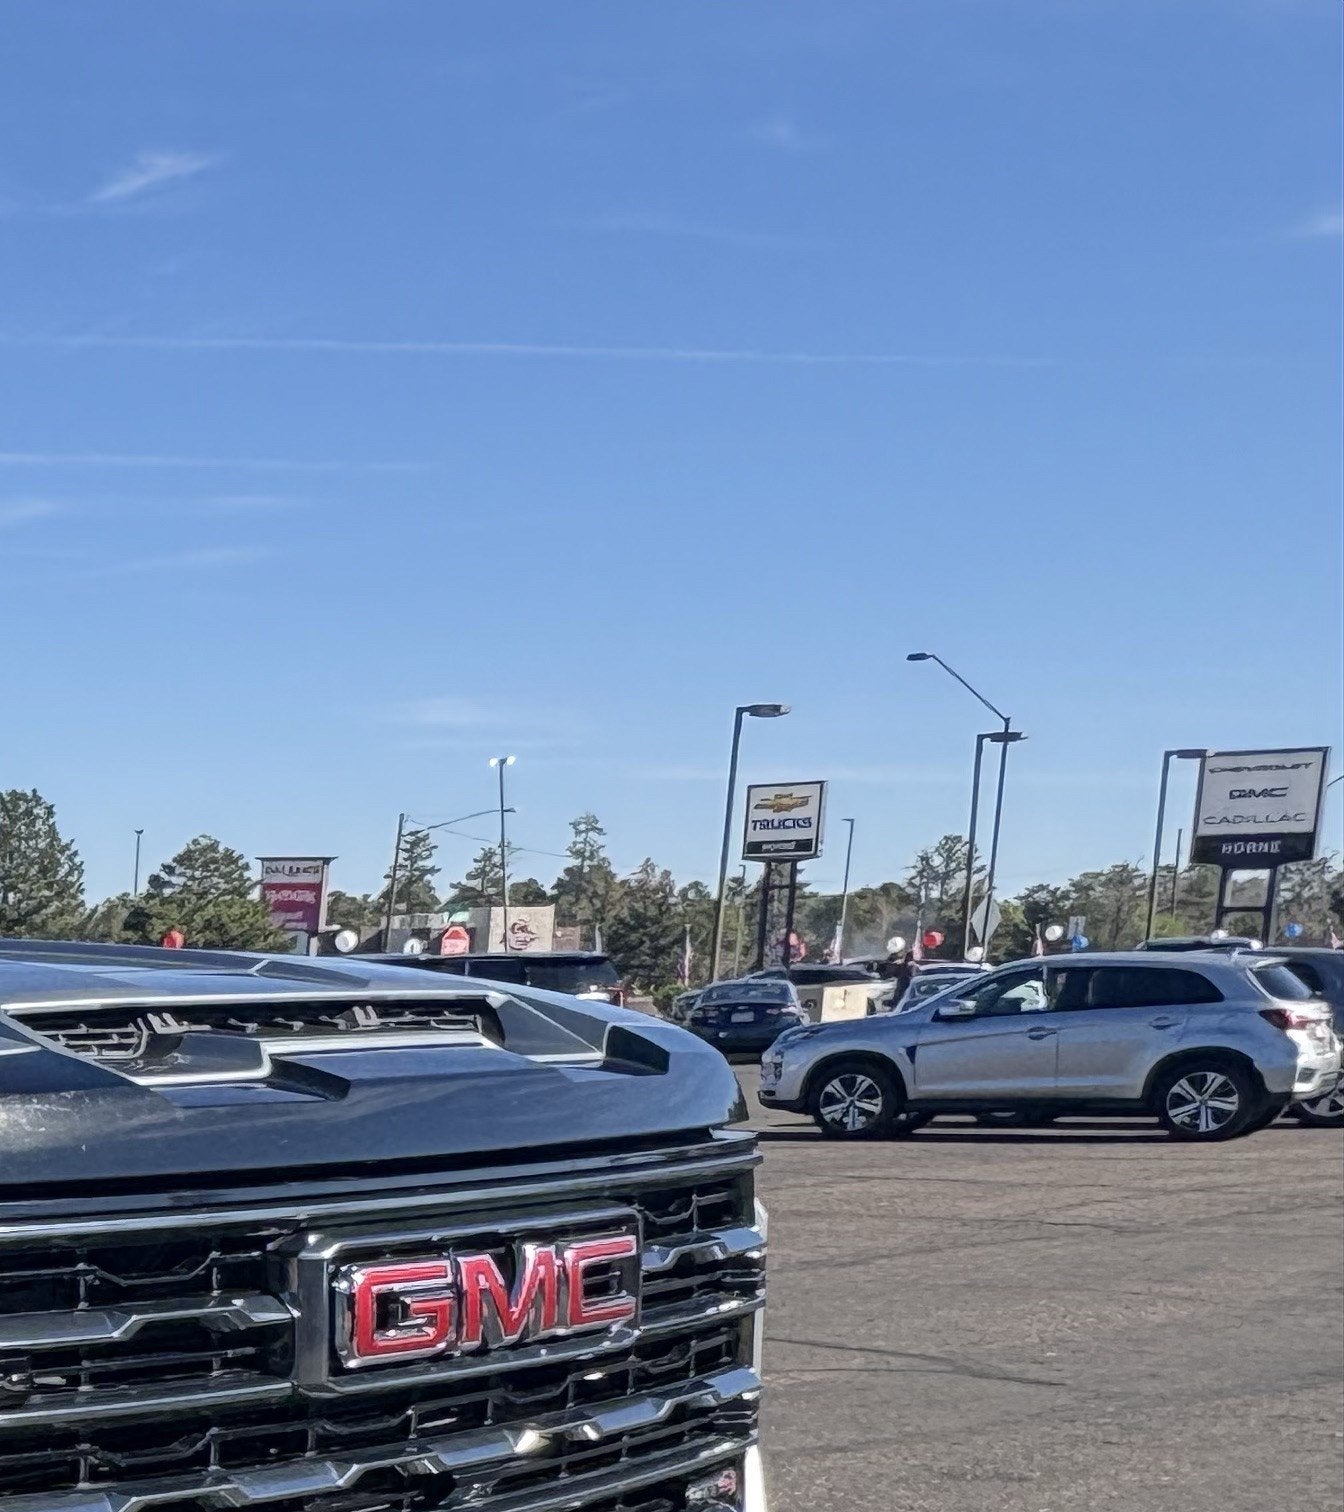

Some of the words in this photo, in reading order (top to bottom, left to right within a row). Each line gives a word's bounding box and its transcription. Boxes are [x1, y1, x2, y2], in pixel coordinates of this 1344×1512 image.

[1229, 786, 1290, 800] GMC
[1203, 812, 1307, 825] CADILLAC
[354, 1234, 637, 1368] GMC
